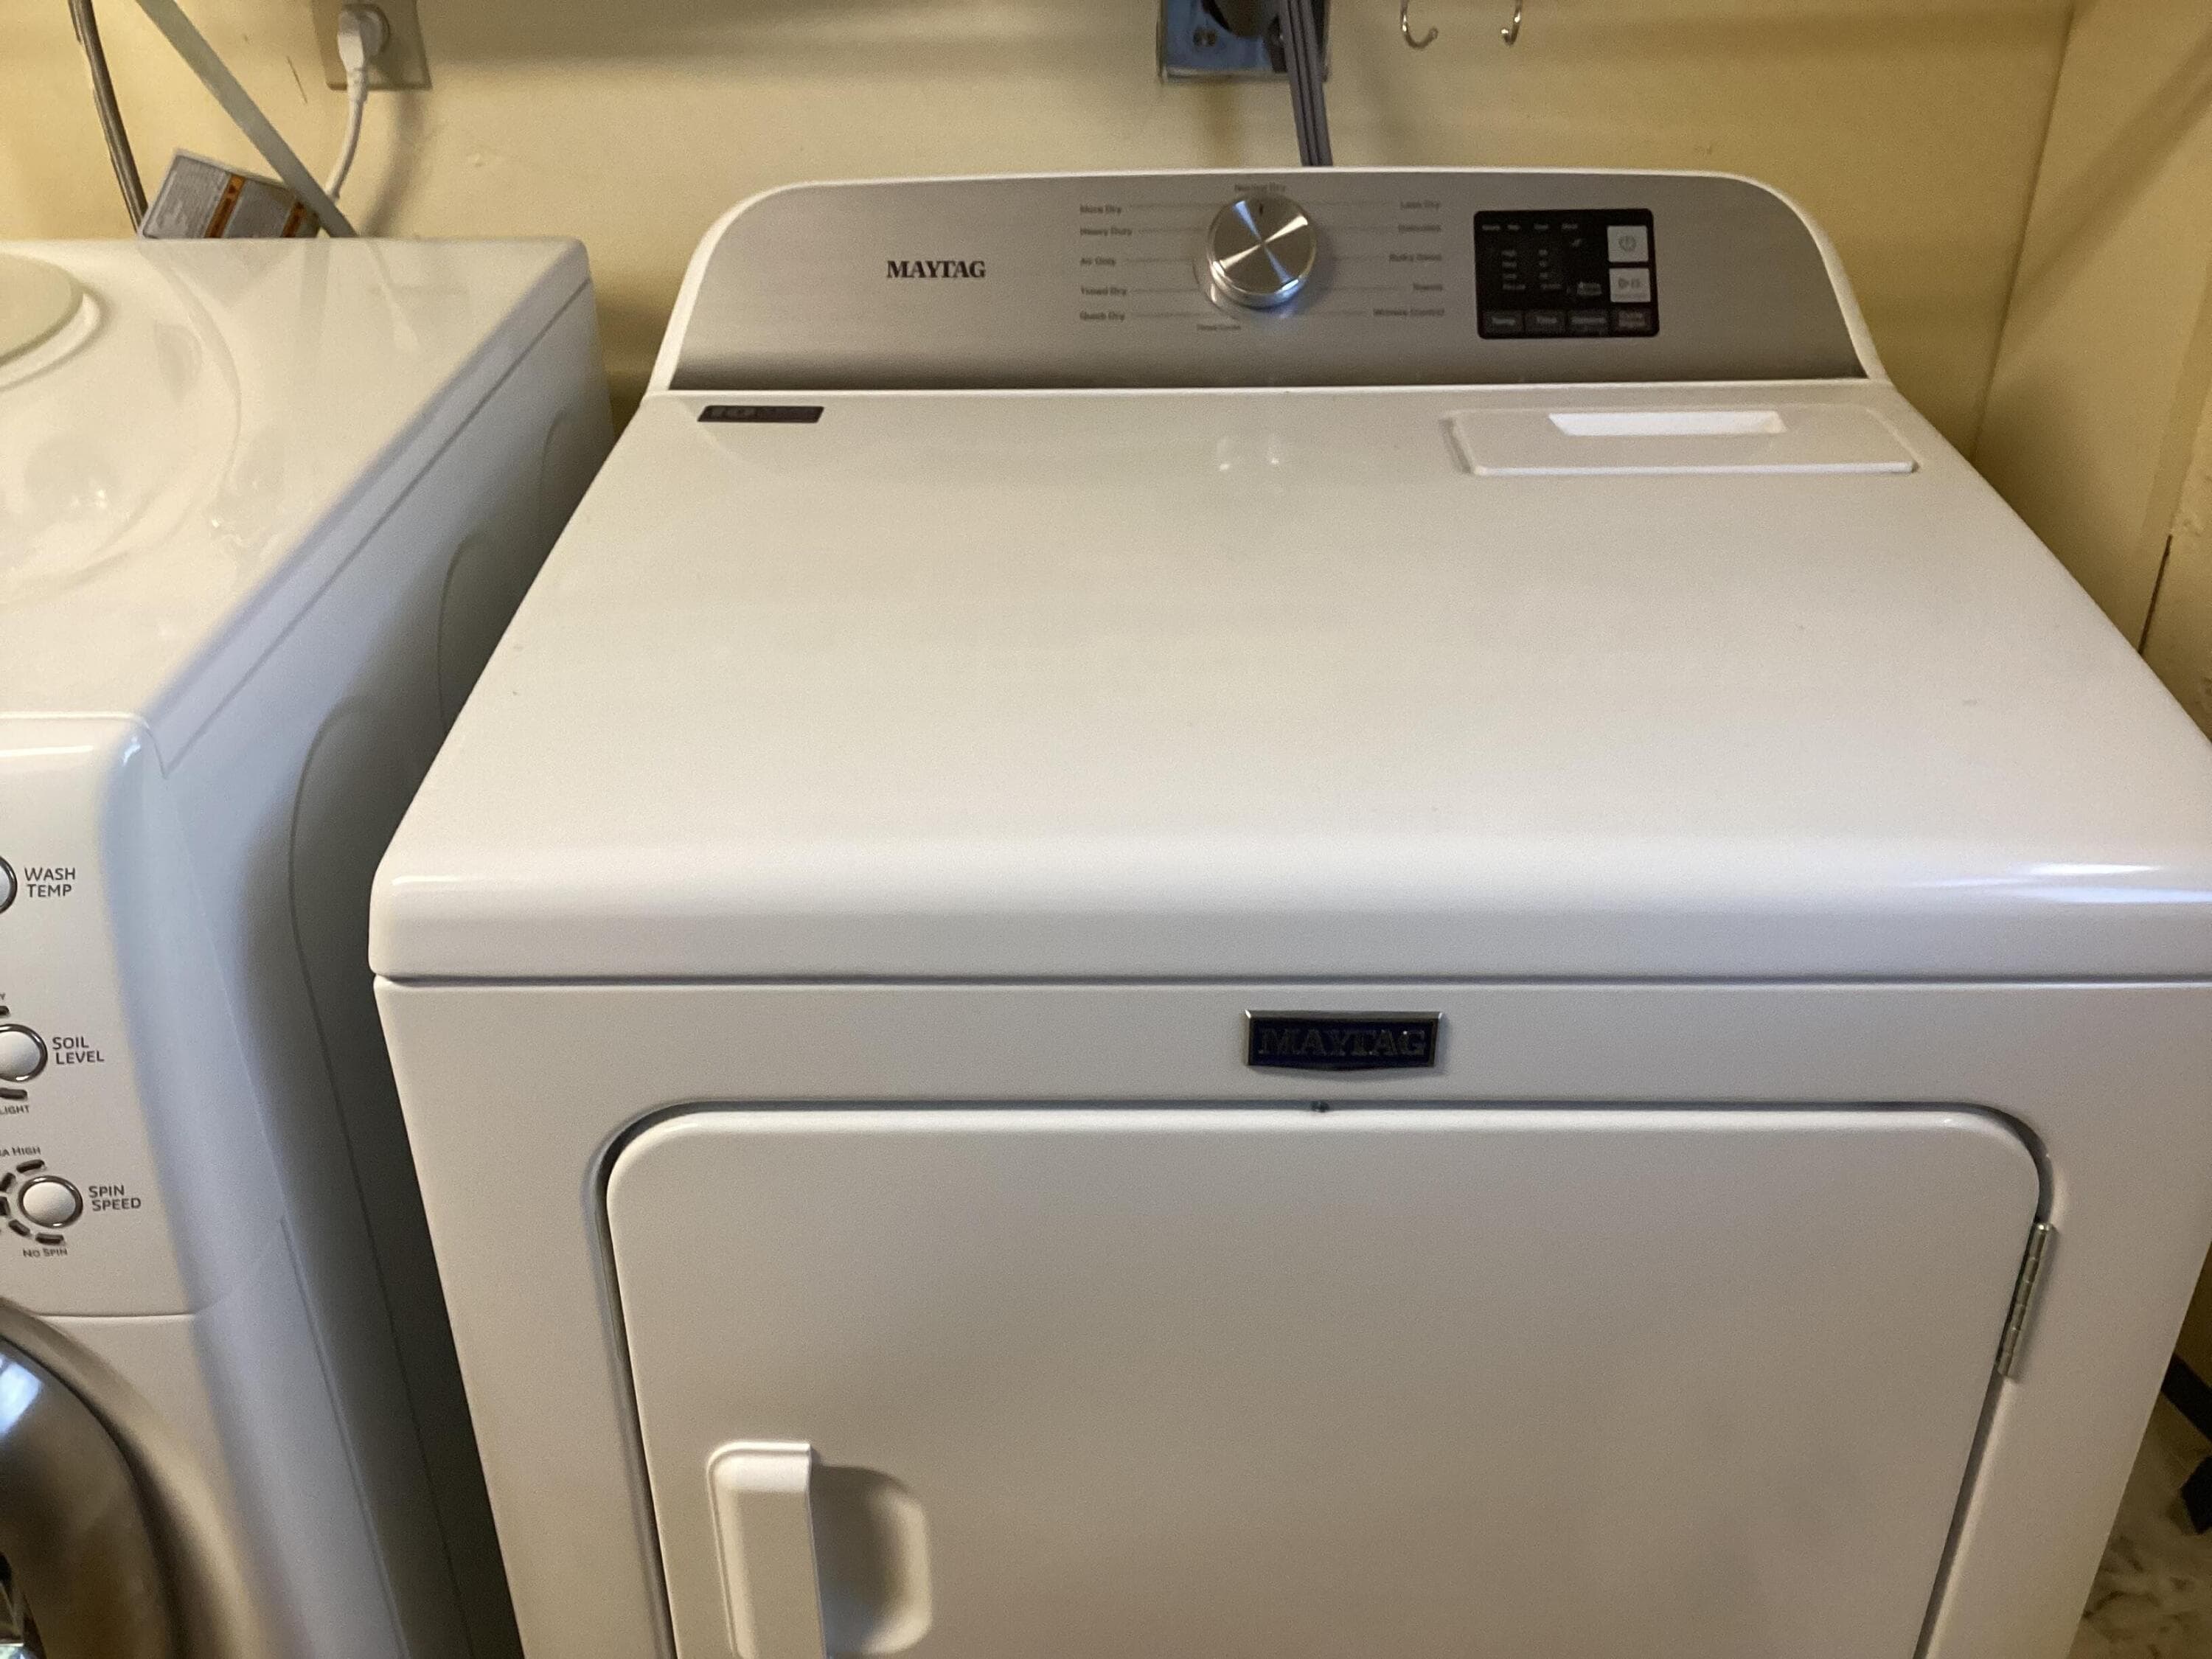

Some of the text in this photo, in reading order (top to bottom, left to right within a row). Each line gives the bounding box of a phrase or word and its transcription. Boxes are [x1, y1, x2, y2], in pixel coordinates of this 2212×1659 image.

[886, 260, 986, 278] MAYTAG
[24, 866, 75, 881] WASH
[27, 883, 72, 897] TEMP
[52, 1036, 89, 1050] SOIL
[1257, 1029, 1425, 1056] MAYTAG
[56, 1050, 105, 1065] LEVEL
[88, 1184, 125, 1198] SPIN
[91, 1197, 142, 1211] SPEED
